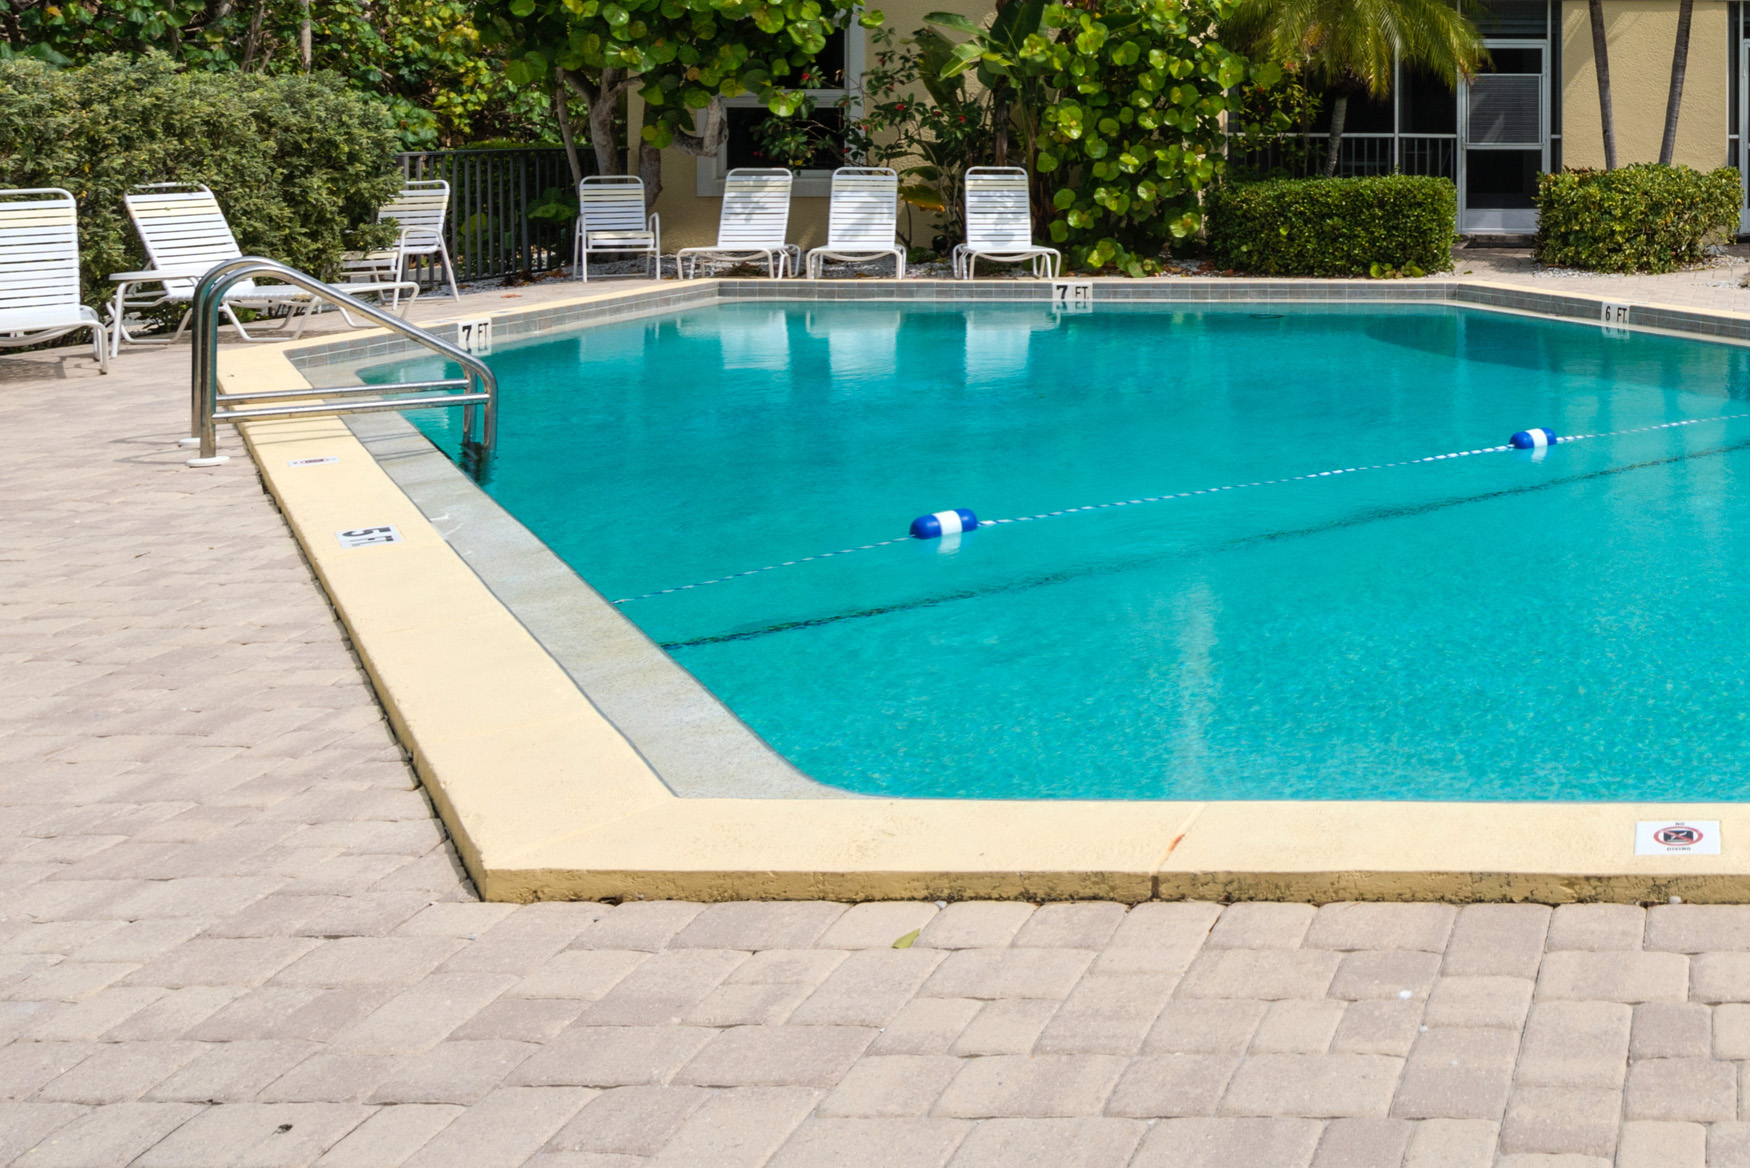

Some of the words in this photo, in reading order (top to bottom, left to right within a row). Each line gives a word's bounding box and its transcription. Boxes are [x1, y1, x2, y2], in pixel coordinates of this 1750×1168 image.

[1056, 285, 1068, 299] 7
[1605, 306, 1611, 321] 6
[462, 325, 472, 341] 7
[342, 527, 391, 537] 5
